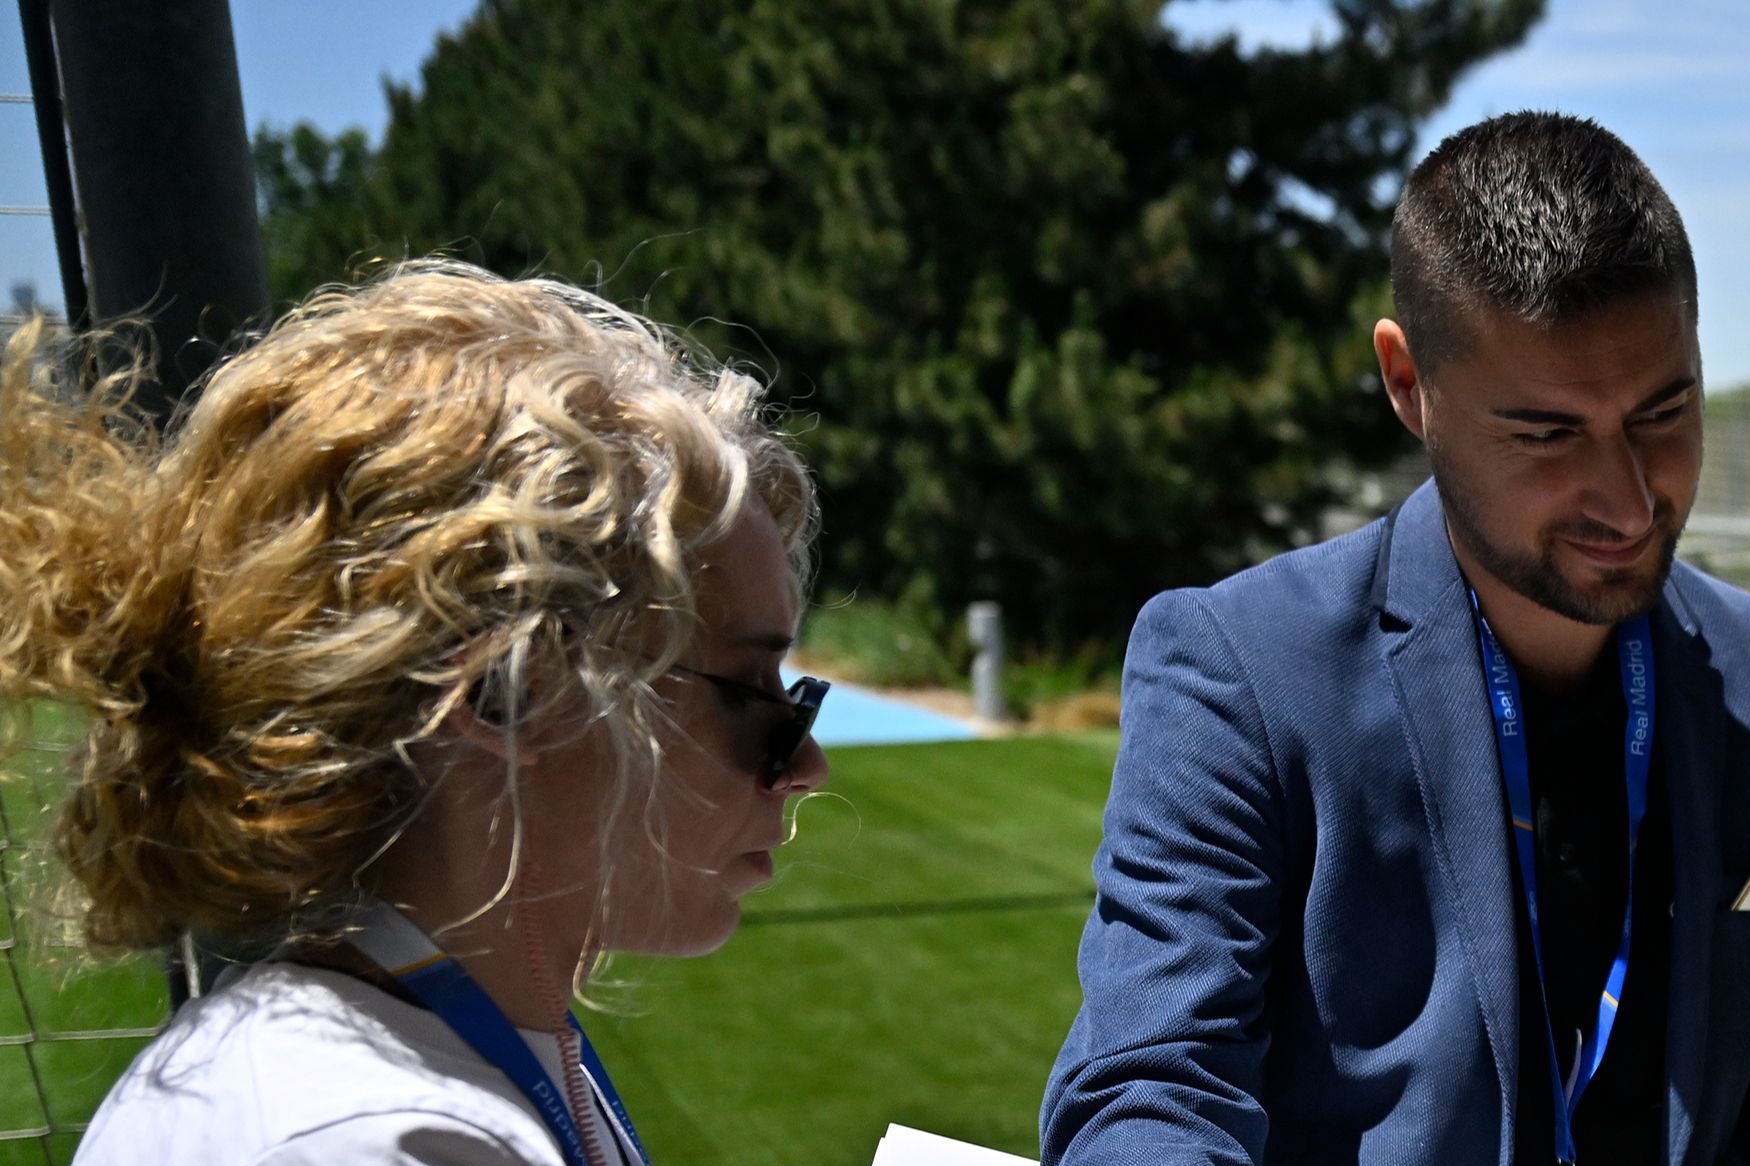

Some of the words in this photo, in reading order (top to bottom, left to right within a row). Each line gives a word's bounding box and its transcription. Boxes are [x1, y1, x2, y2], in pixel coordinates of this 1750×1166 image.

[1624, 638, 1647, 706] Madrid
[1496, 689, 1519, 736] Real
[1630, 710, 1649, 756] Real
